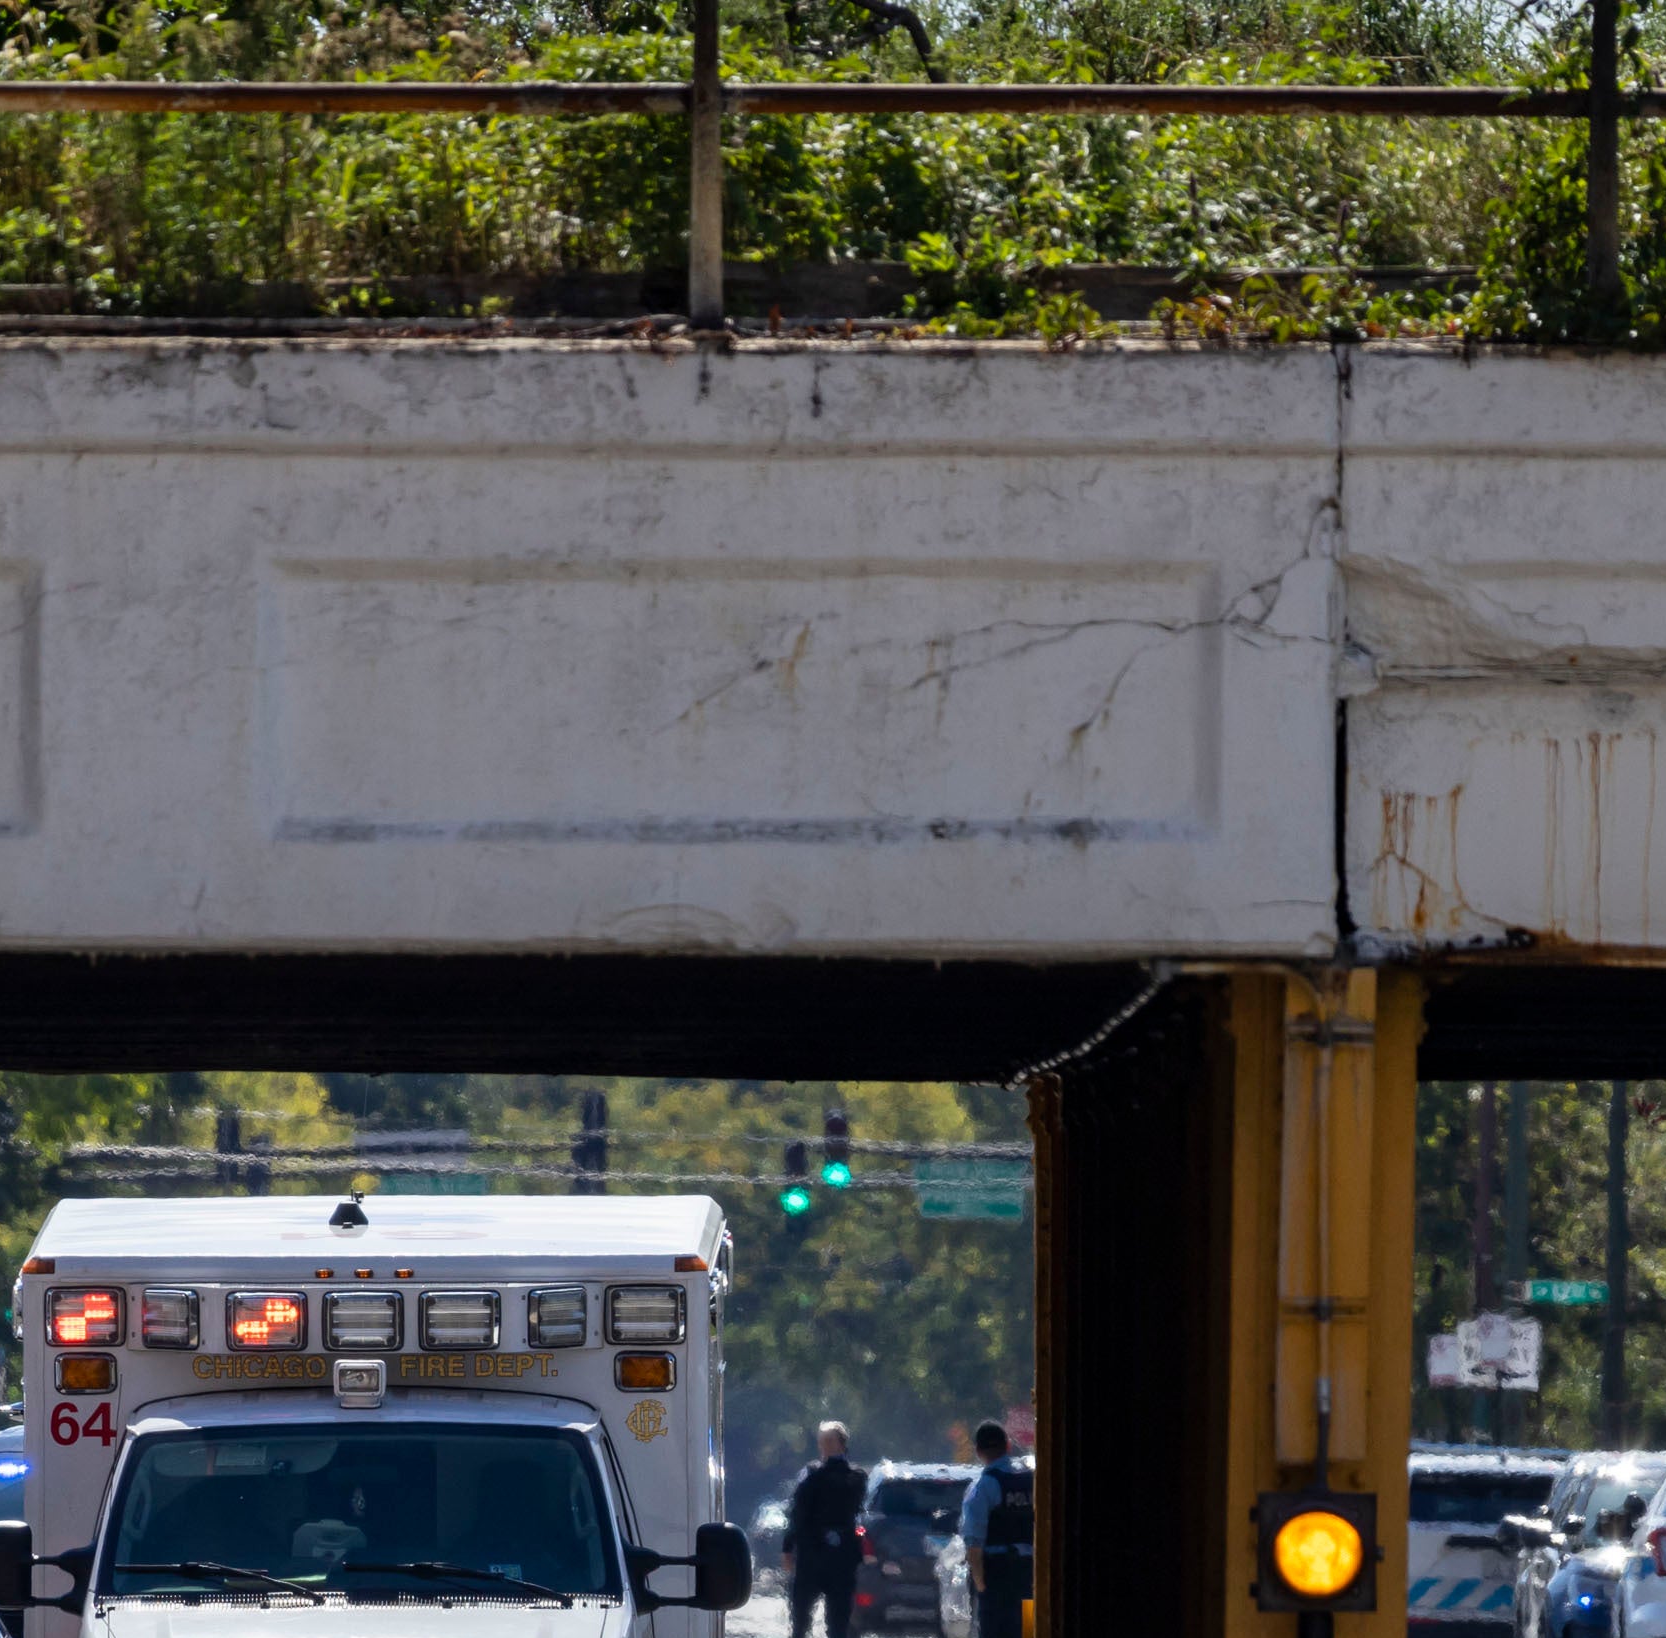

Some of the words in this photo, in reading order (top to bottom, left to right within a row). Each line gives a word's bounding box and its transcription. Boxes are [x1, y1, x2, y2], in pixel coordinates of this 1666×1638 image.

[192, 1355, 327, 1379] CHICAGO
[399, 1355, 466, 1377] FIRE
[474, 1354, 559, 1378] DEPT.
[50, 1402, 117, 1447] 64
